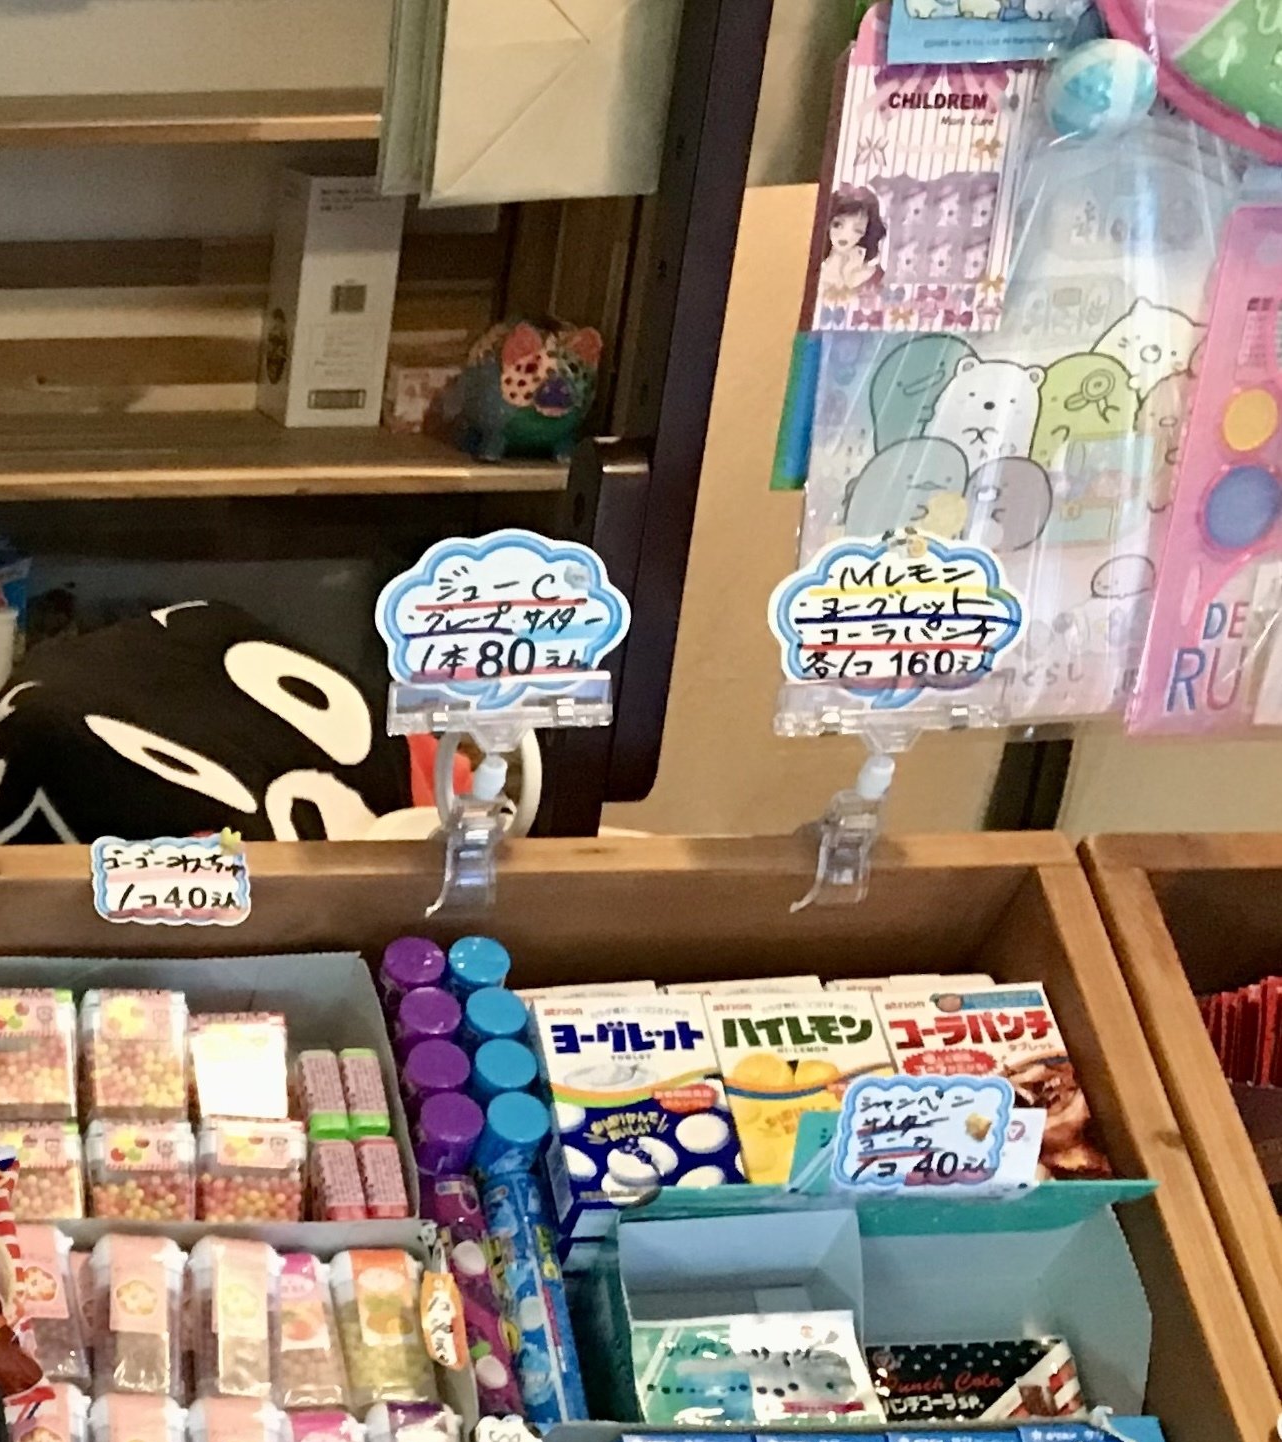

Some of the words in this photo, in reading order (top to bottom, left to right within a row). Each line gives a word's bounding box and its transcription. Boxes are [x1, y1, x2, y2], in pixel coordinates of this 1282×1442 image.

[552, 1022, 704, 1055] ヨーグレット
[723, 1016, 872, 1049] ハイレモン
[888, 1011, 1053, 1049] コーラパンチ
